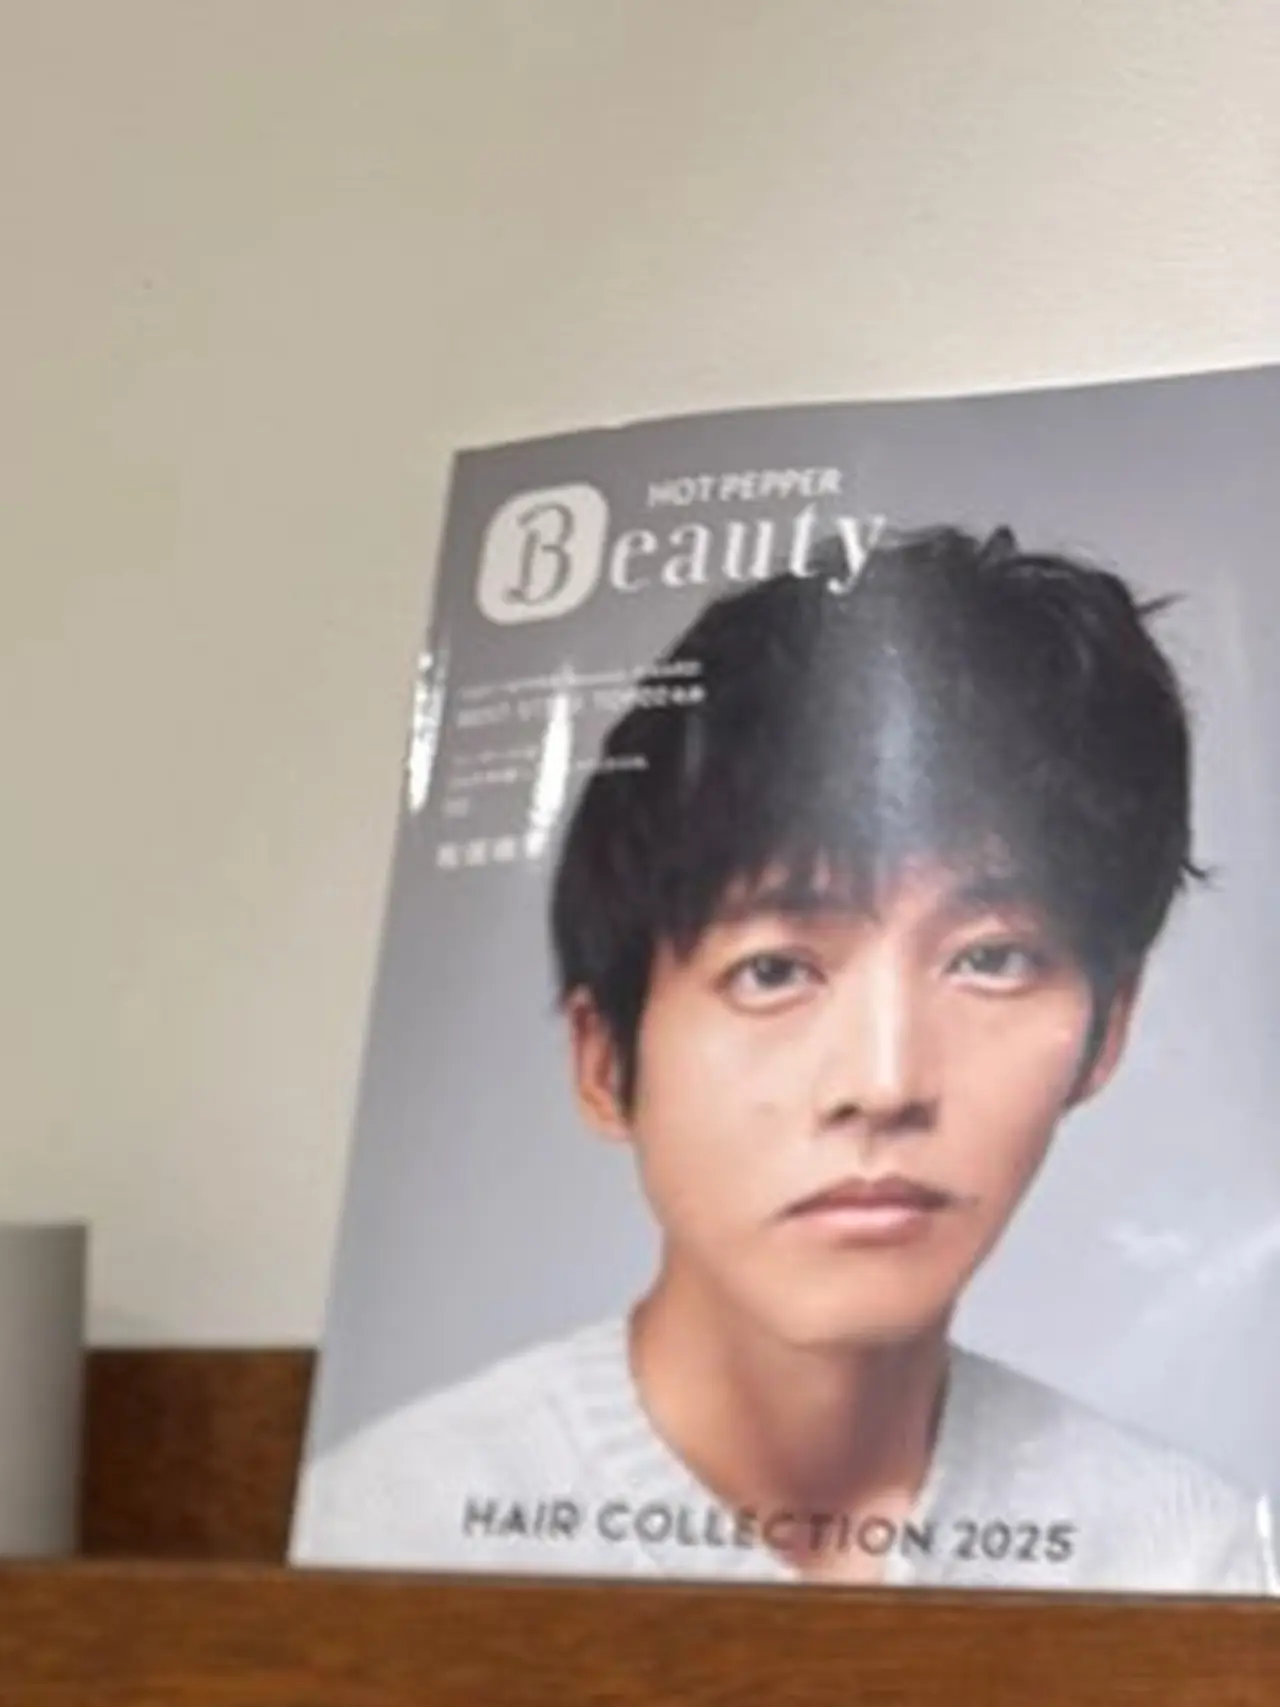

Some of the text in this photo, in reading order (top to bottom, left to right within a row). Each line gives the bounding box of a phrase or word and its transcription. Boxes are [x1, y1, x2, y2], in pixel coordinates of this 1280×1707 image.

[648, 467, 842, 507] HOT PEPPER
[502, 502, 887, 607] Beauty
[462, 1497, 1076, 1562] HAIR COLLECTION 2025
